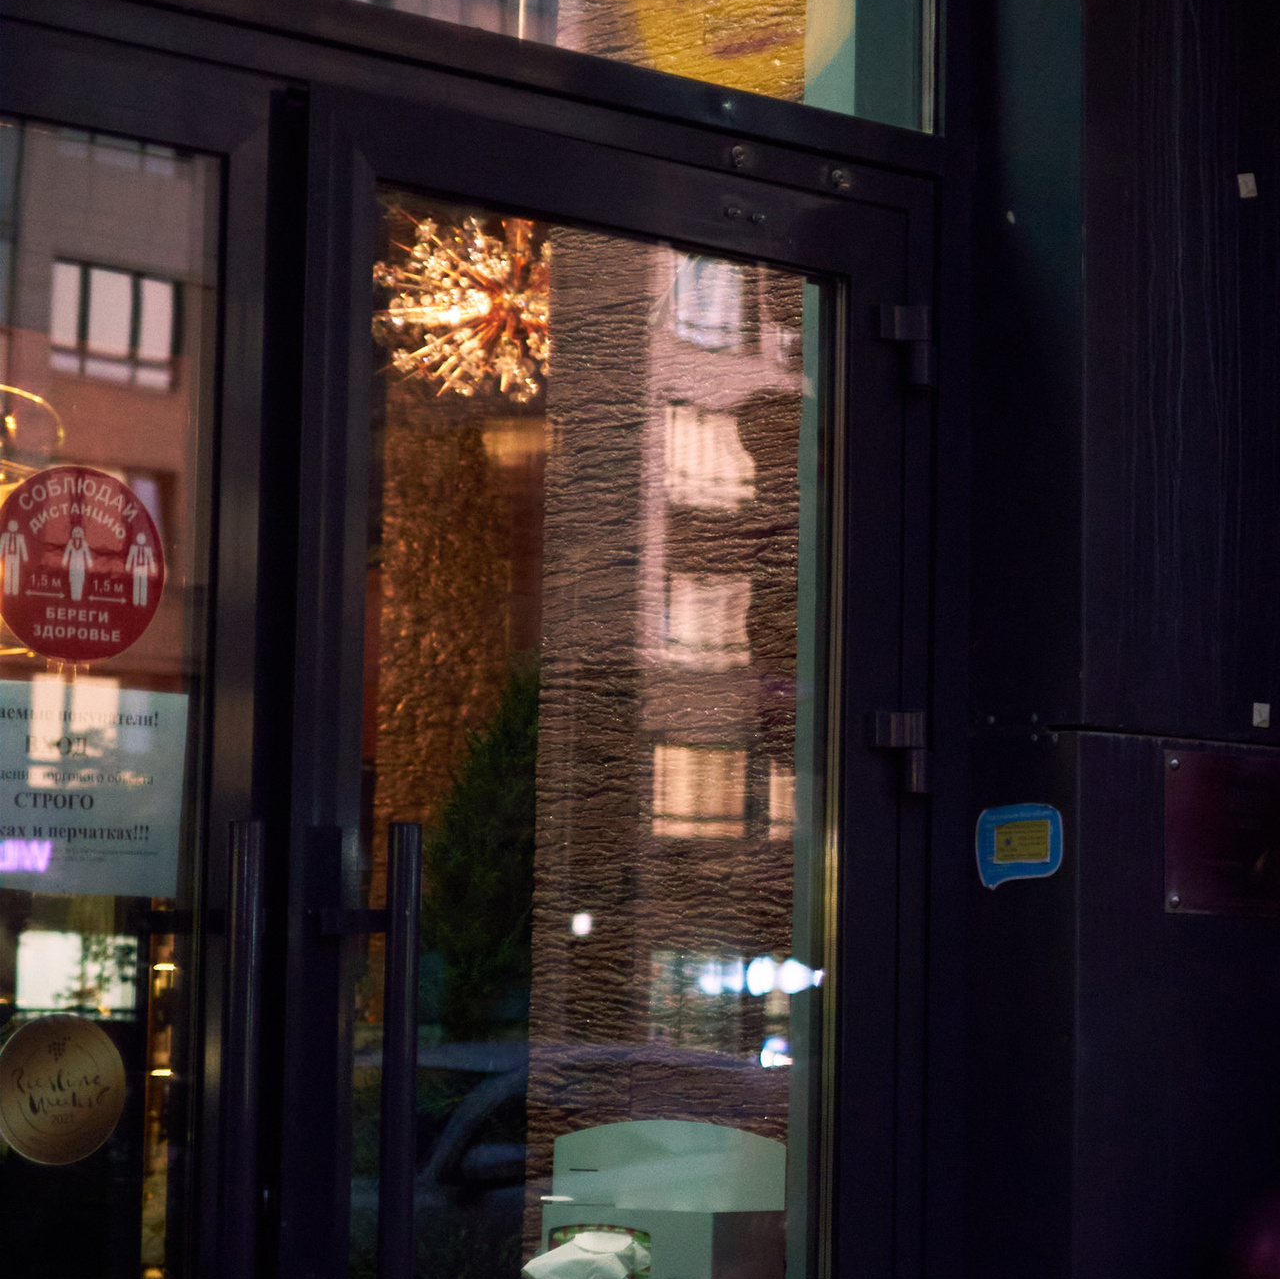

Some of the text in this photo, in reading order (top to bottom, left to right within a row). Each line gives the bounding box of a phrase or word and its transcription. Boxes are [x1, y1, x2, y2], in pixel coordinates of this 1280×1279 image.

[18, 476, 139, 523] СОБЛЮДАЙ
[29, 502, 127, 539] ДИСТАНЦИЮ
[30, 573, 48, 588] 1,5
[93, 579, 111, 594] 1,5
[45, 606, 109, 623] БЕРЕГИ
[32, 623, 121, 643] ЗДОРОВЬЕ
[14, 792, 95, 810] СТРОГО
[32, 826, 43, 838] и
[48, 825, 150, 842] перчатках!!!
